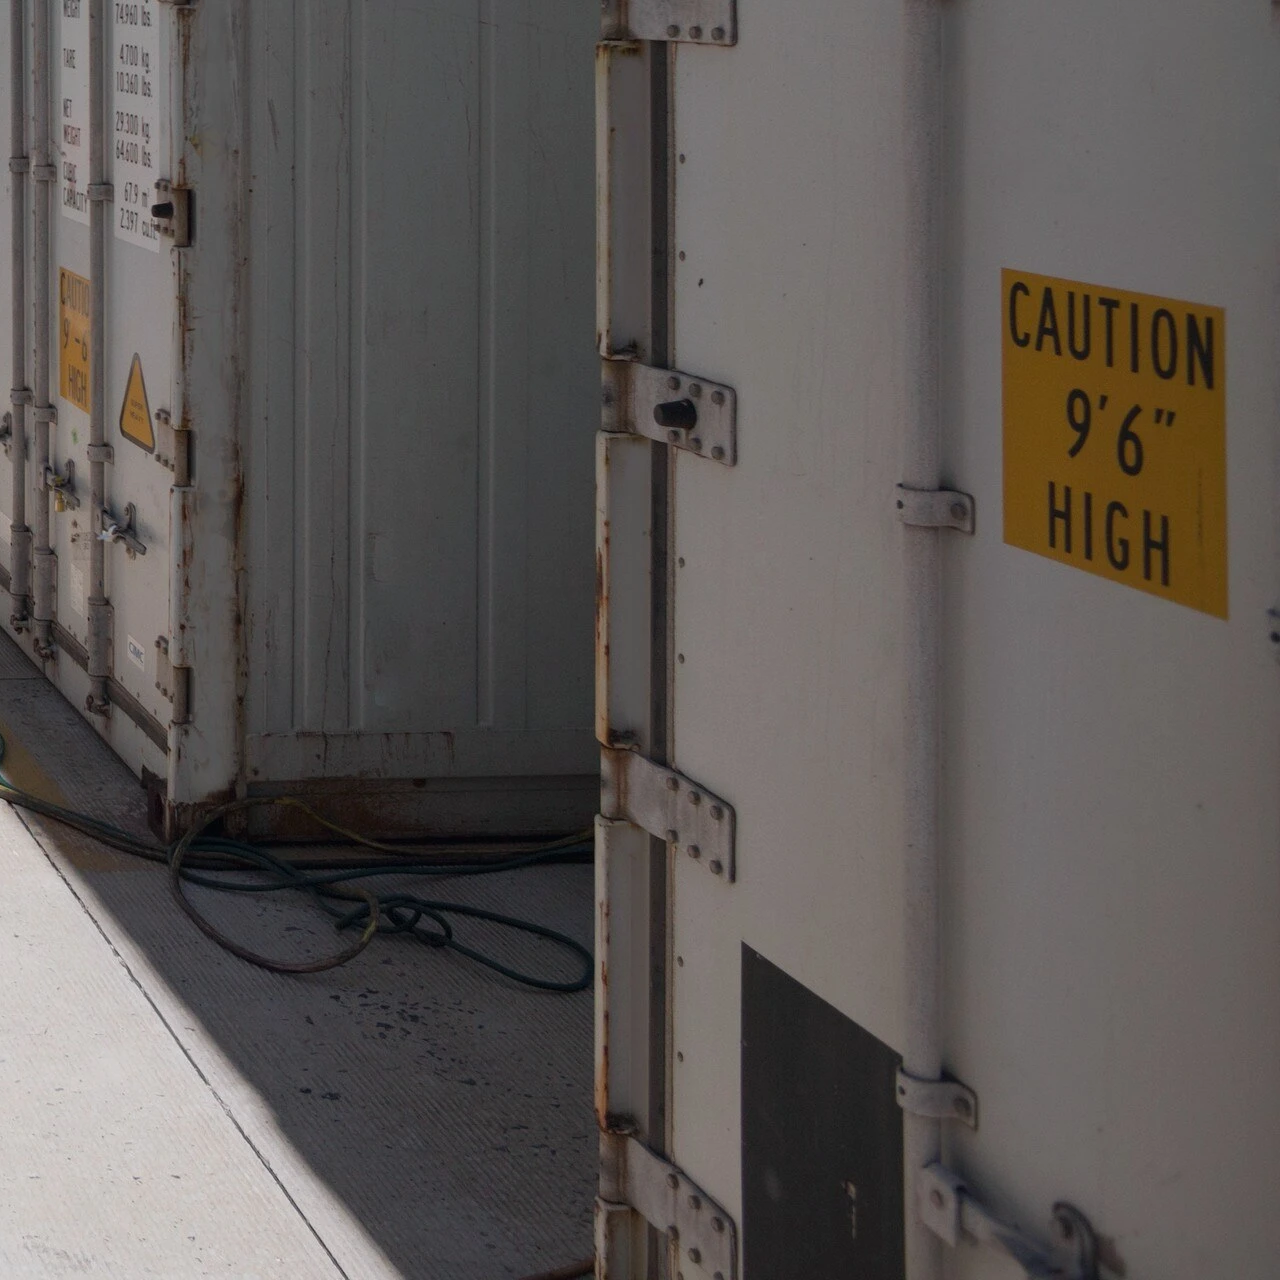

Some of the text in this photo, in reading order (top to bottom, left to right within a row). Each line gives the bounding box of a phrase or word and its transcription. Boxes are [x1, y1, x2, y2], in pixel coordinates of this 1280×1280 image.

[115, 2, 138, 26] 74.960
[63, 47, 76, 69] TARE
[119, 43, 138, 66] 4.700
[116, 71, 139, 95] 10.360
[63, 97, 73, 118] NET
[116, 110, 139, 136] 29.300
[63, 124, 81, 147] WEIGHT
[116, 139, 139, 165] 64.600
[120, 207, 139, 233] 2.397
[1008, 280, 1215, 391] CAUTION
[68, 363, 87, 408] HIGH
[1047, 480, 1171, 587] HIGH
